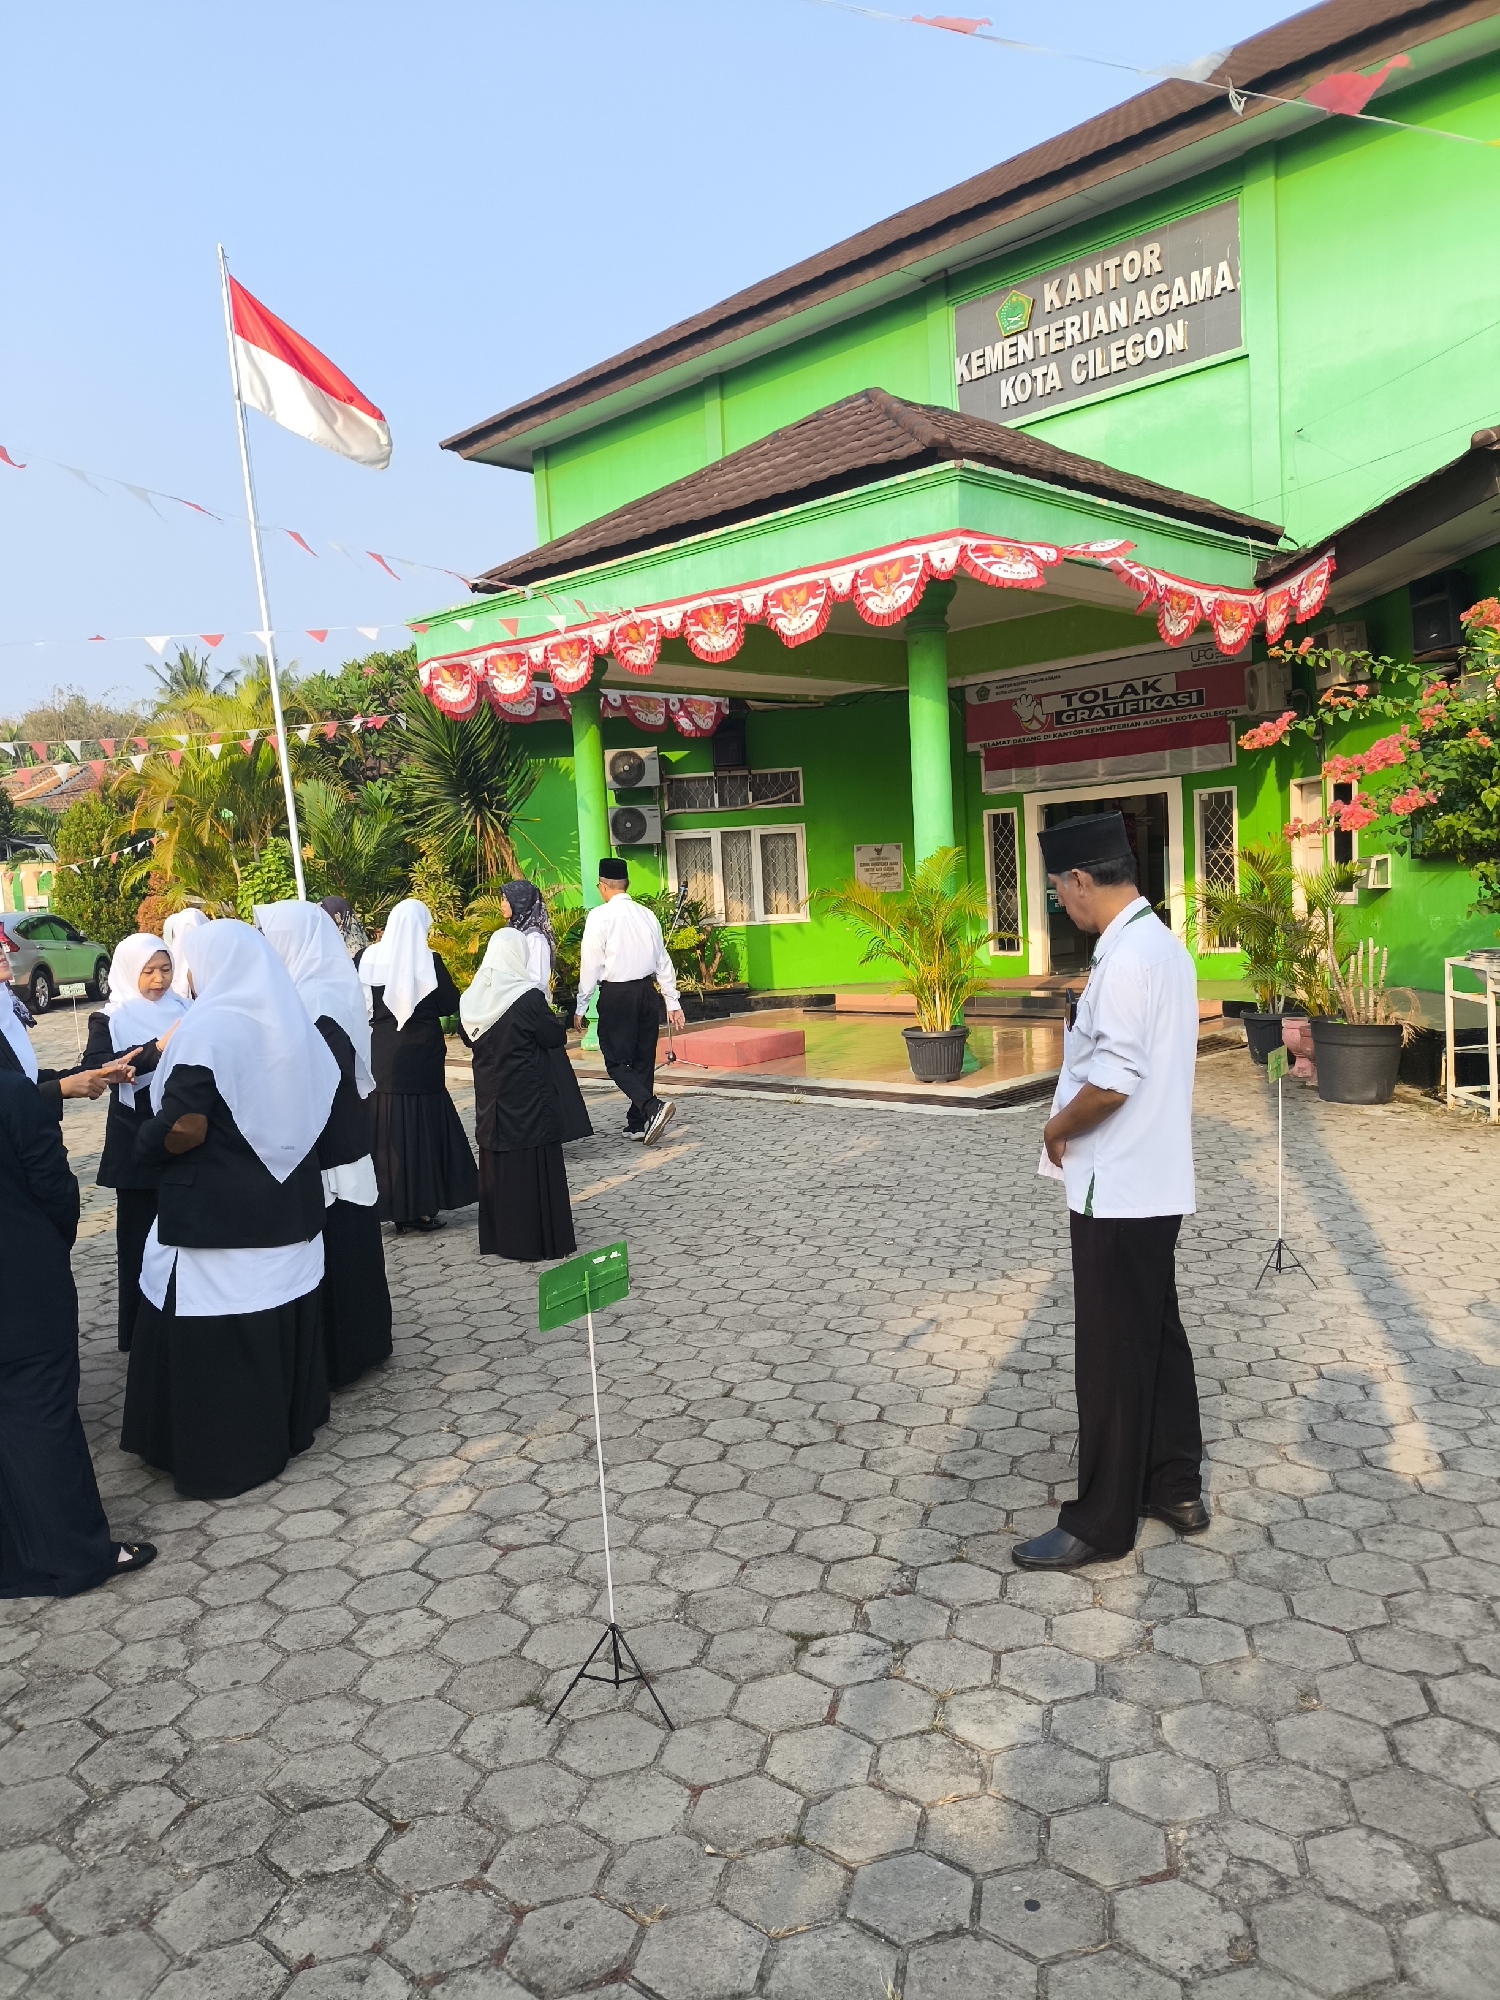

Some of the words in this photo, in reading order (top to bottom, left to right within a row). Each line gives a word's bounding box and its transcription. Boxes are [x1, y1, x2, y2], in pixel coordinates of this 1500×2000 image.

[1043, 242, 1164, 314] KANTOR
[955, 296, 1130, 387] KEMENTERIAN
[1133, 260, 1236, 326] AGAMA
[1000, 361, 1065, 410] KOTA
[1071, 318, 1187, 386] CILEGON
[1190, 647, 1214, 663] UPG
[1061, 678, 1163, 708] TOLAK
[1061, 691, 1197, 723] GRATIFIKASI
[979, 739, 1011, 749] SELAMAT
[1012, 735, 1042, 744] DATANG
[1053, 729, 1083, 739] KANTOR
[1085, 721, 1141, 735] KEMENTERIAN
[1143, 716, 1173, 726] AGAMA
[1175, 712, 1198, 722] KOTA
[1200, 708, 1238, 719] CILEGON
